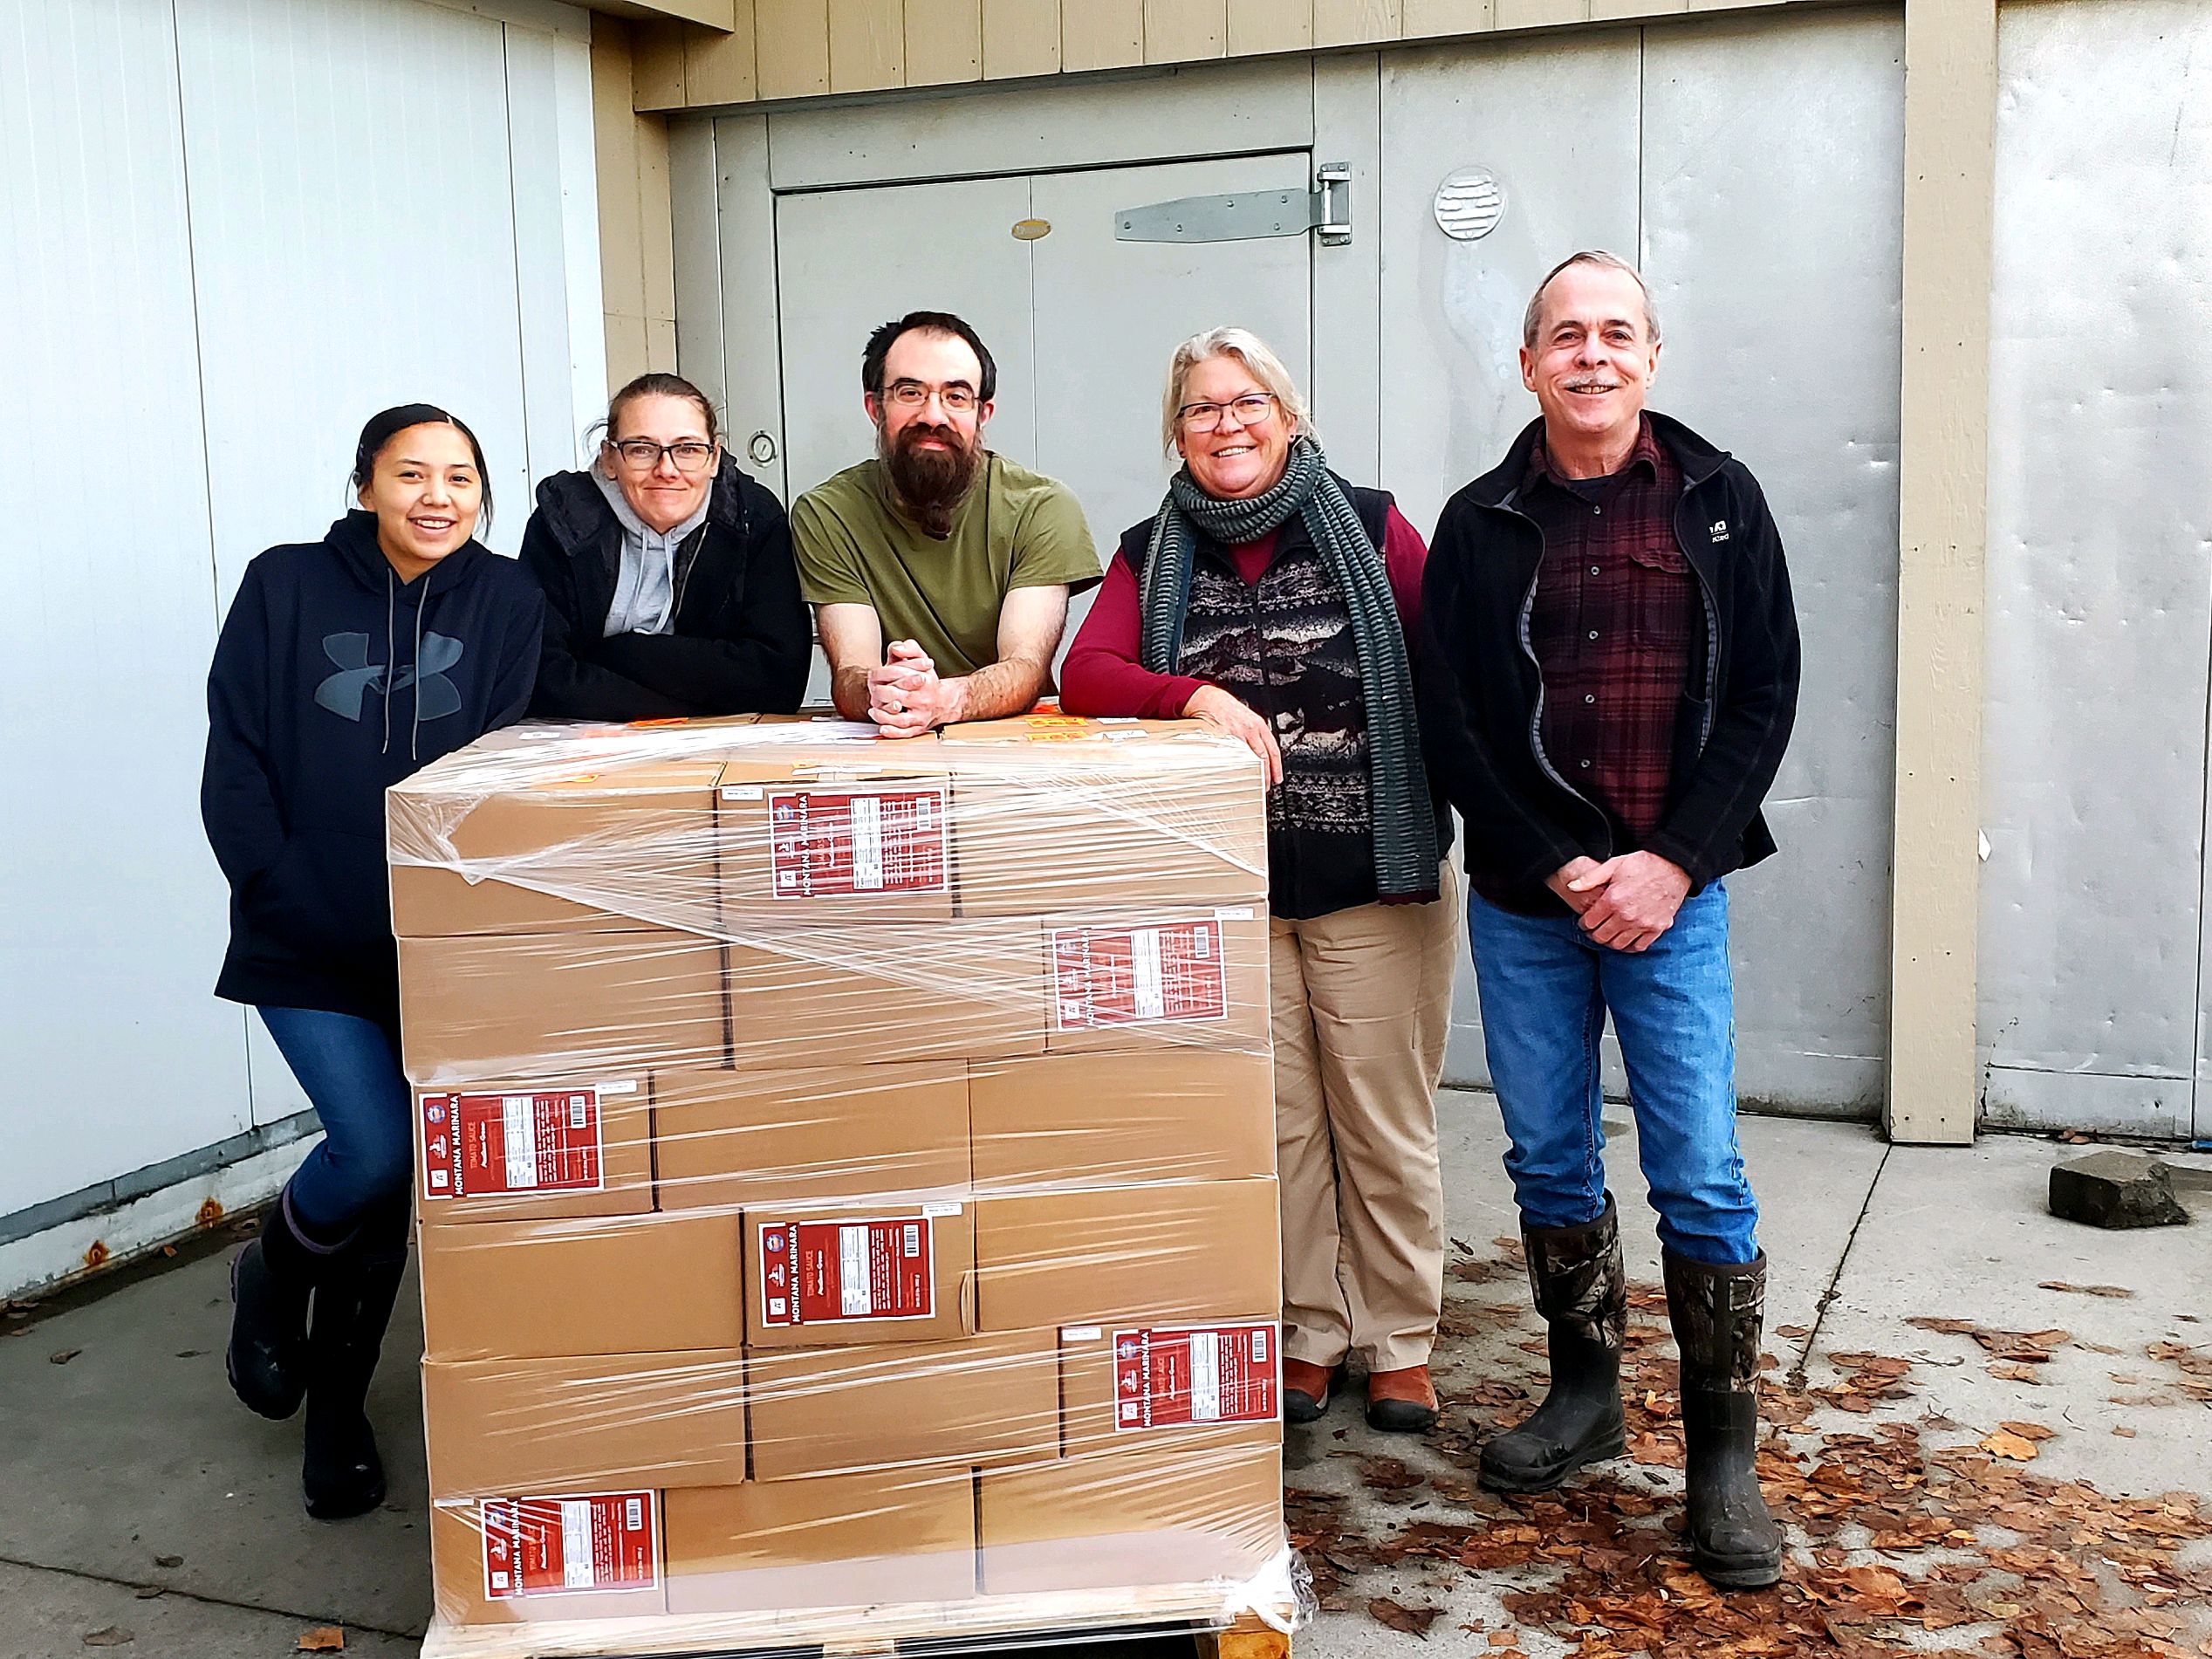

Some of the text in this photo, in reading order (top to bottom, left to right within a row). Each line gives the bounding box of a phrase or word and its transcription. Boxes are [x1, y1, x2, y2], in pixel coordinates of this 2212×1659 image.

[801, 847, 812, 896] MONTANA
[449, 1095, 464, 1196] MONTANA MARINARA
[468, 1121, 478, 1169] TOMATO SAUCE
[788, 1224, 801, 1323] MONTANA MARINARA
[805, 1249, 815, 1298] TOMATO SAUCE
[1140, 1332, 1152, 1428] MONTANA MARINARA
[509, 1500, 524, 1596] MONTANA MARINARA
